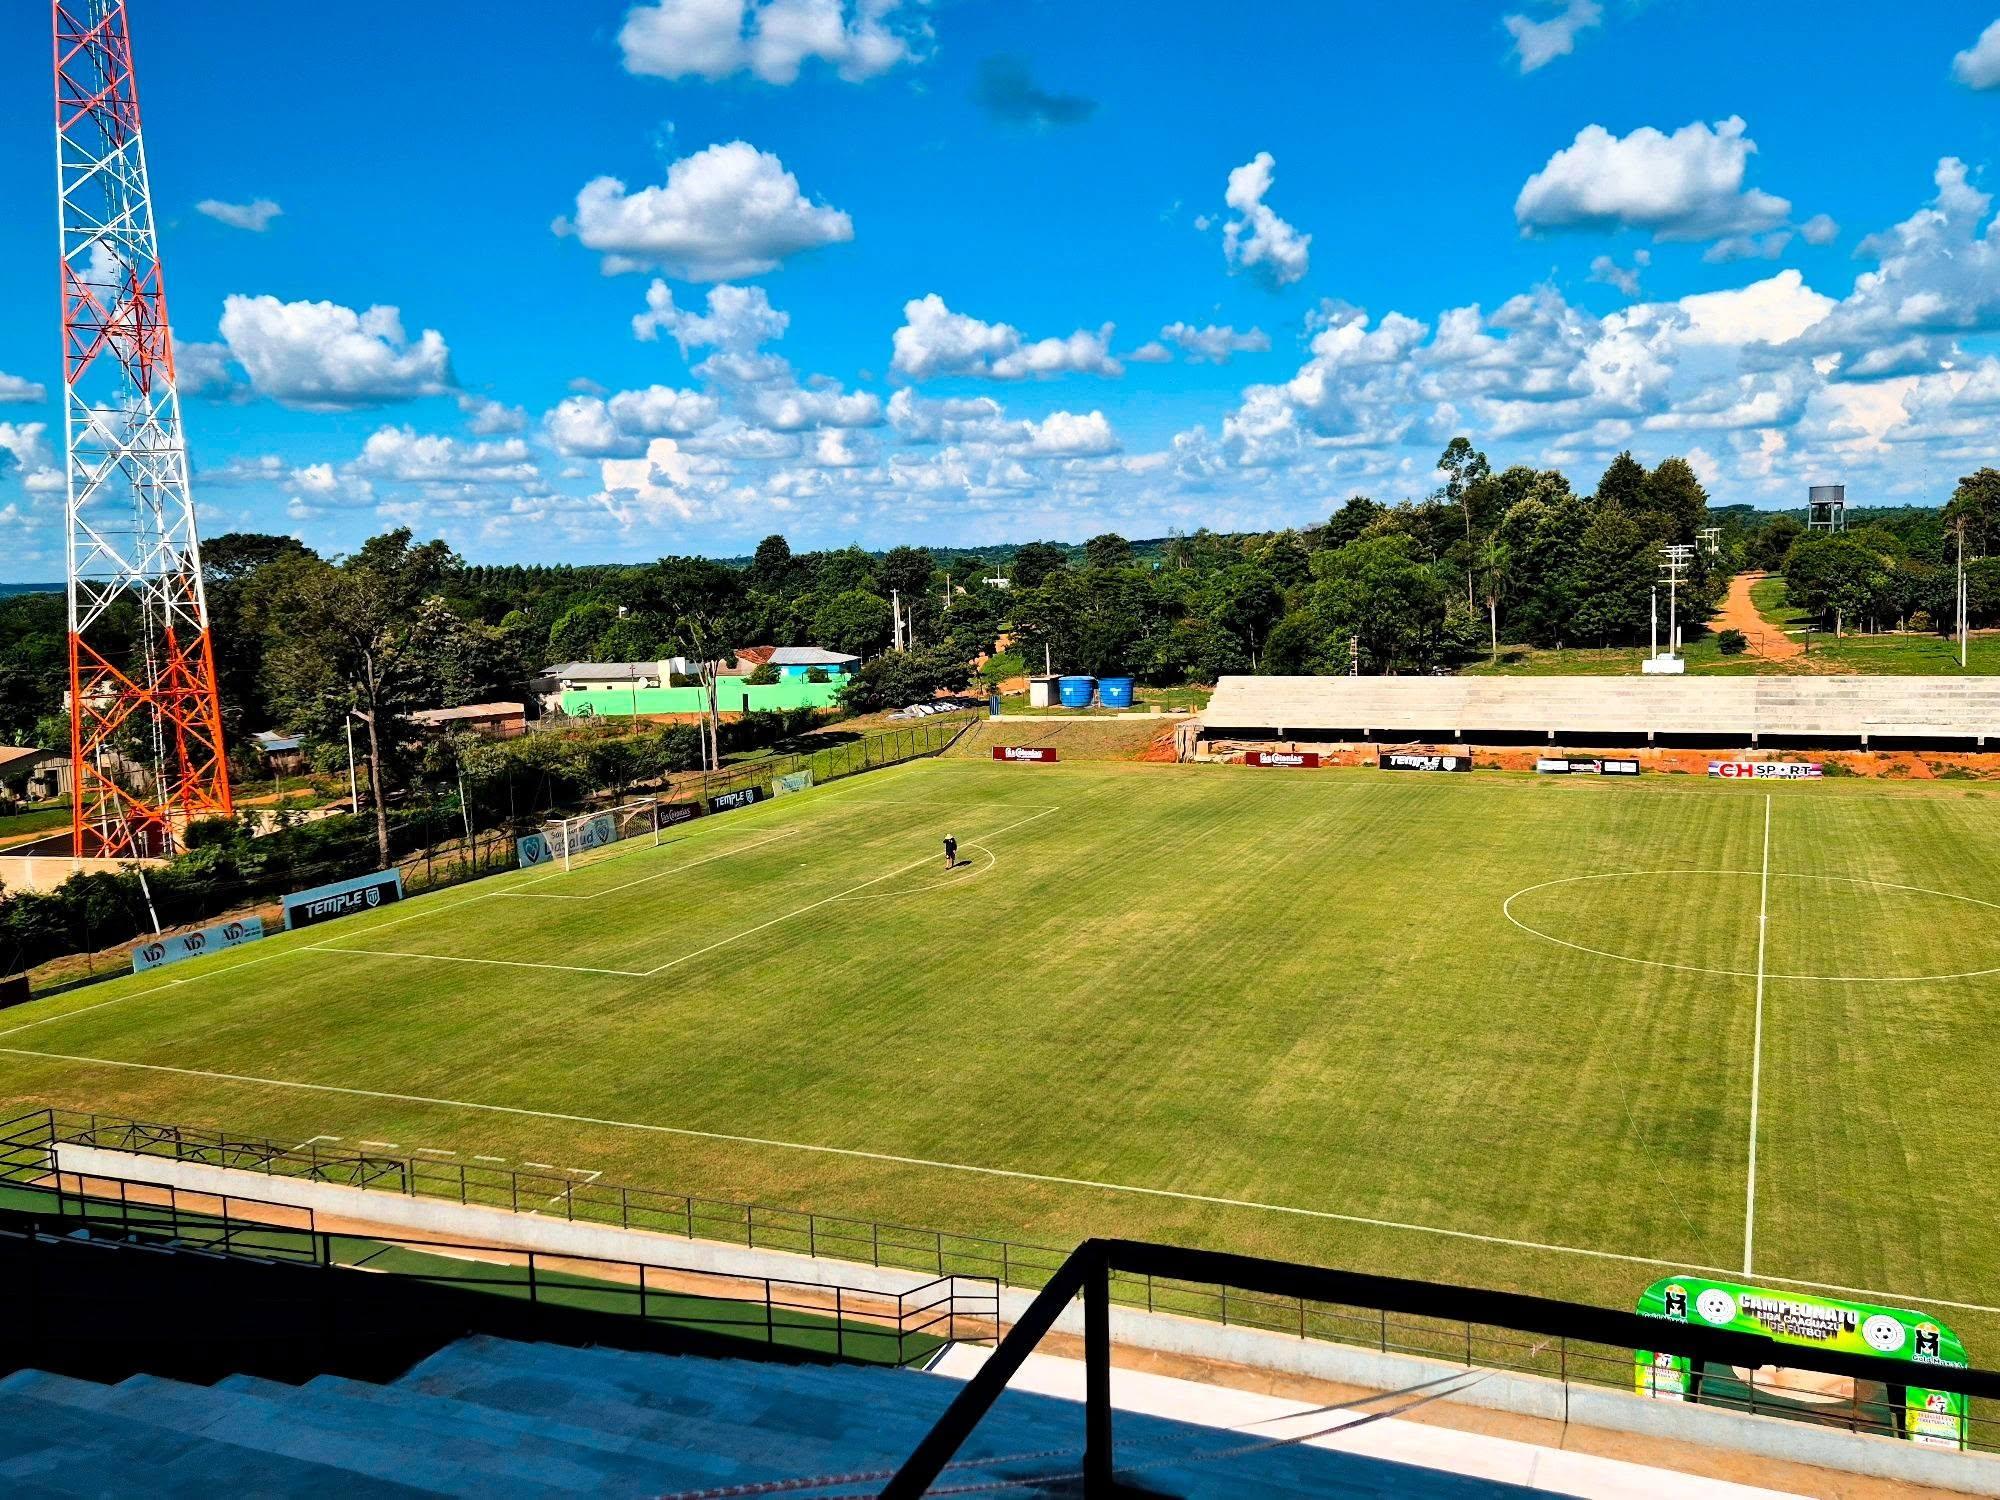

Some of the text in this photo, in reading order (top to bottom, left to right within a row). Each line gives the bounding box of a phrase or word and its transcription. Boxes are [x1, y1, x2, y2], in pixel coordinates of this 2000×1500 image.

[1390, 756, 1441, 767] TEMPLE
[1720, 763, 1753, 778] CH
[715, 791, 745, 808] TEMPLE
[306, 890, 363, 918] TEMPLE
